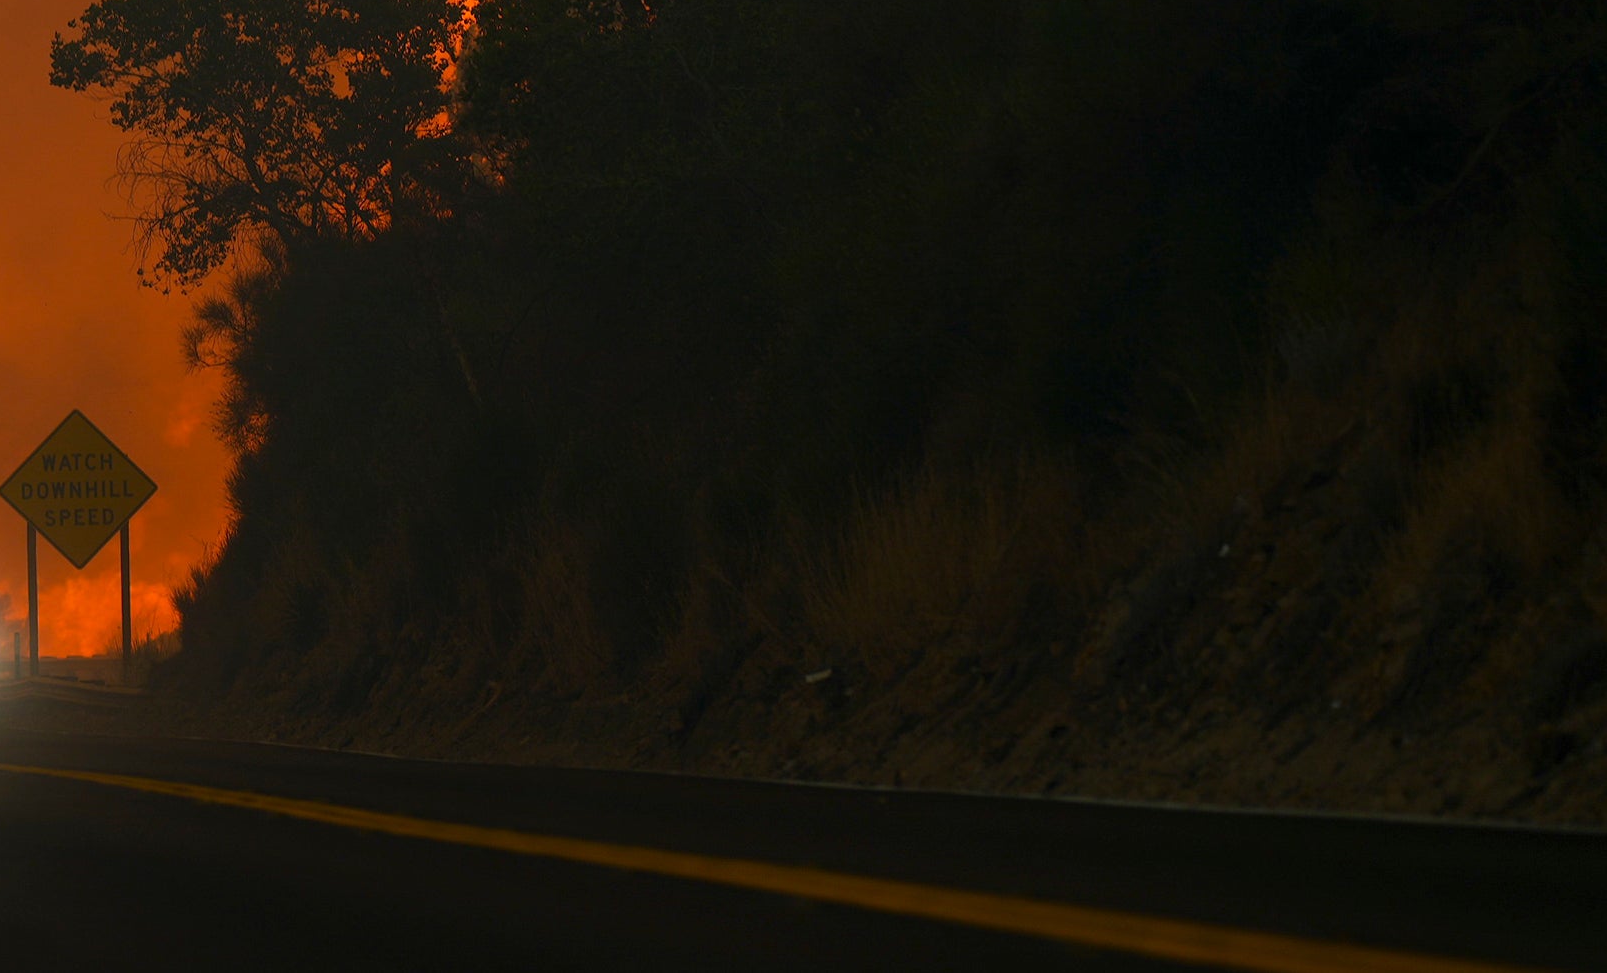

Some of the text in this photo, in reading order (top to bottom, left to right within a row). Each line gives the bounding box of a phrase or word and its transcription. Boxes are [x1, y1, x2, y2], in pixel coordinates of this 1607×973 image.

[42, 453, 114, 472] WATCH
[21, 480, 134, 500] DOWNHILL
[45, 508, 115, 527] SPEED
